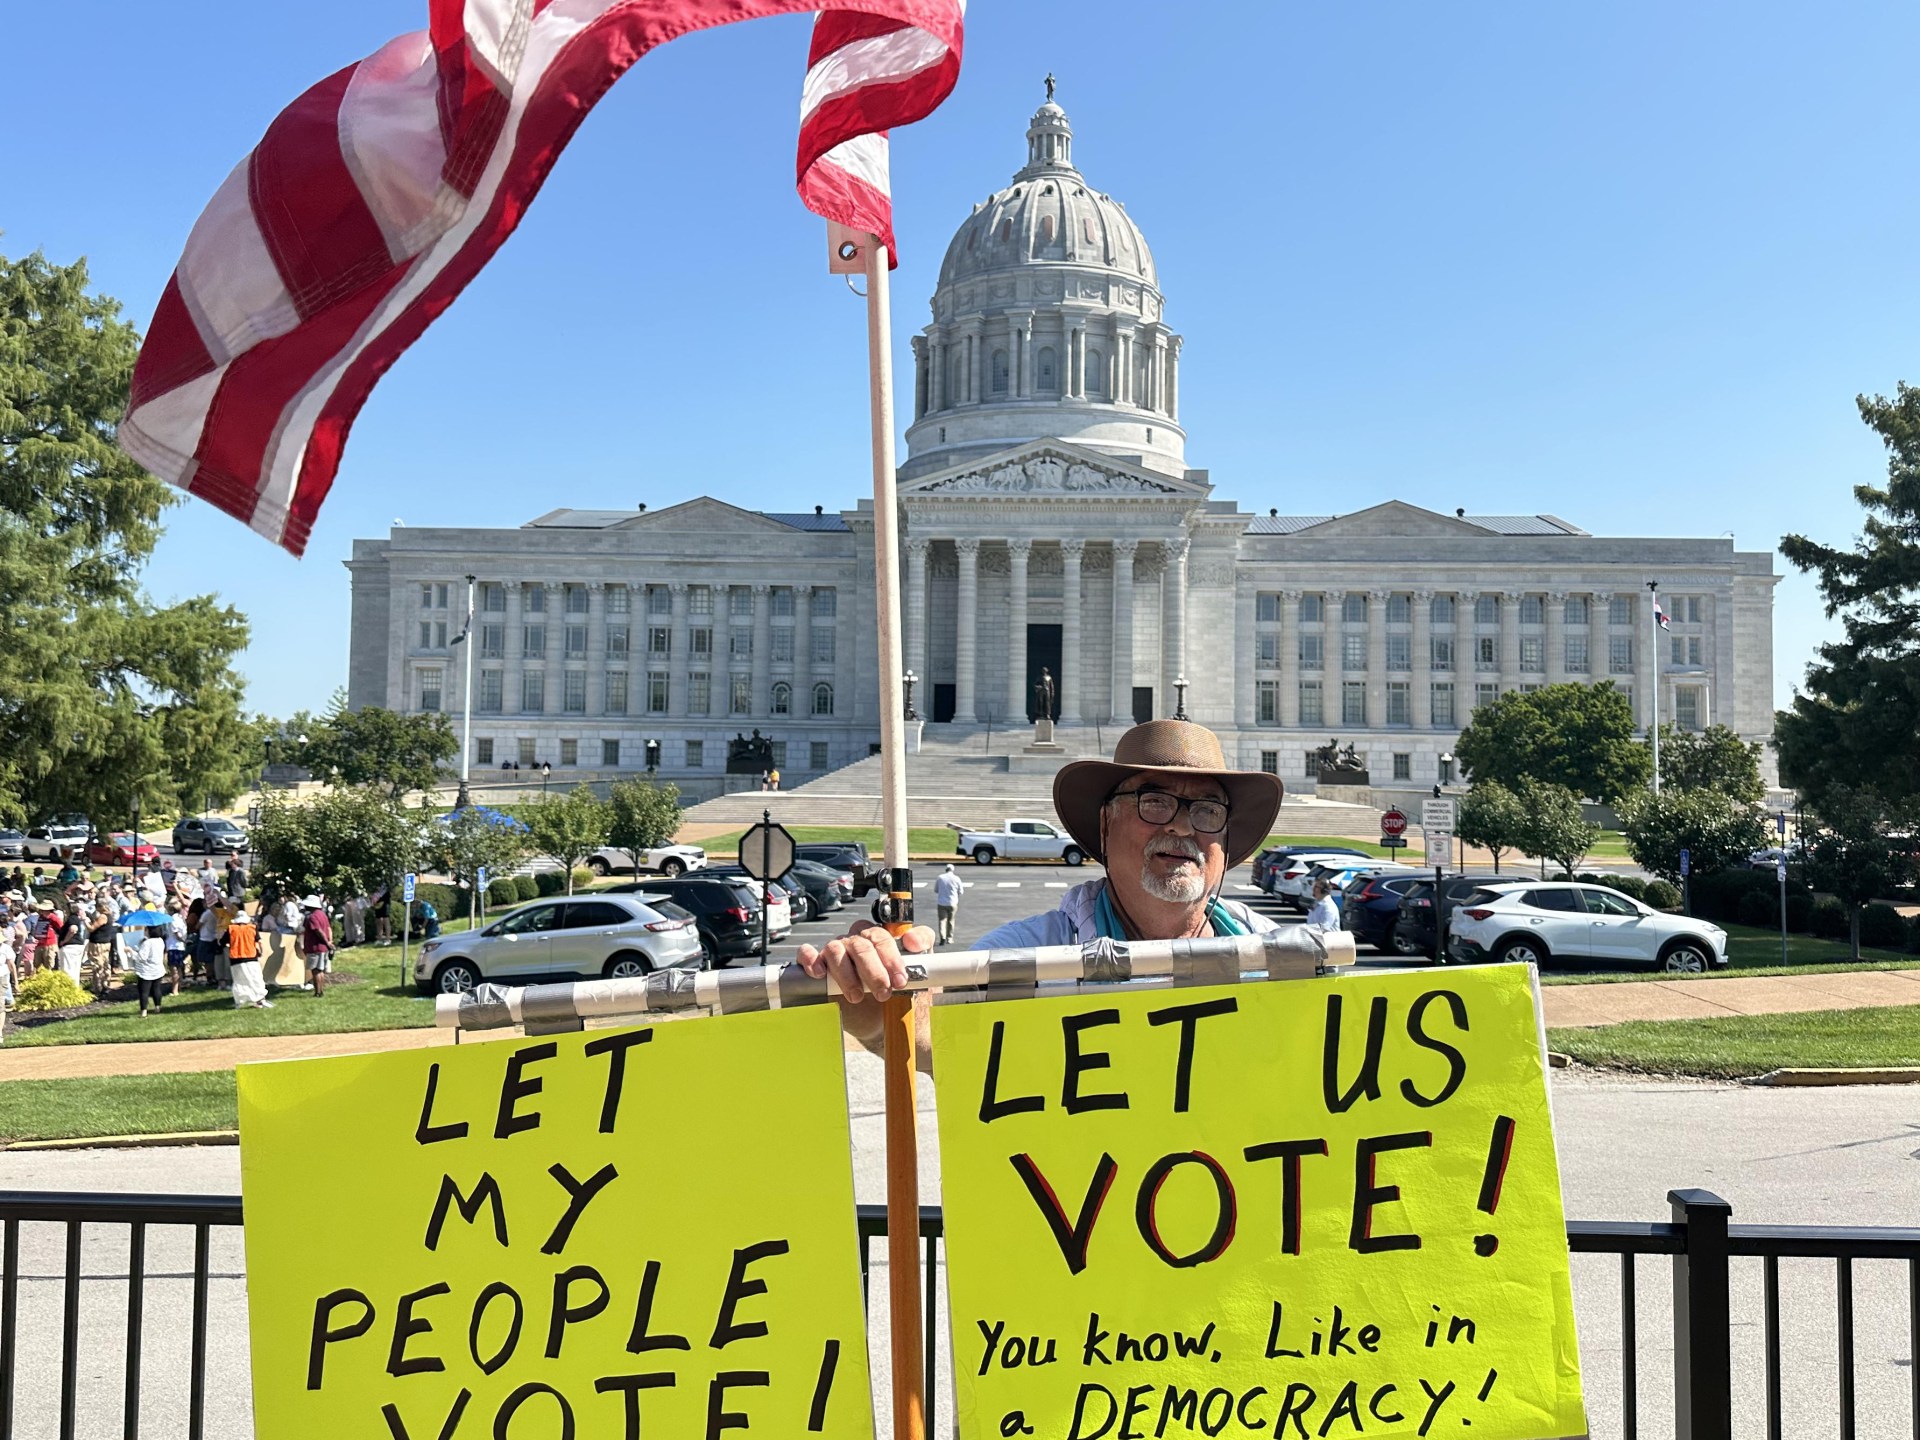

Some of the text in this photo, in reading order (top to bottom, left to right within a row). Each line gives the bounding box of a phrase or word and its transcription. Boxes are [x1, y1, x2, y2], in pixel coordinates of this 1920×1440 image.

[1383, 818, 1405, 828] STOP
[415, 1027, 654, 1146] LET
[979, 990, 1470, 1124] LET US
[424, 1162, 619, 1256] MY
[1009, 1114, 1516, 1276] VOTE!
[306, 1239, 790, 1391] PEOPLE
[976, 1319, 1058, 1376] You
[1265, 1300, 1382, 1360] Like
[1425, 1304, 1477, 1348] in
[999, 1367, 1499, 1440] a DEMOCRACY!
